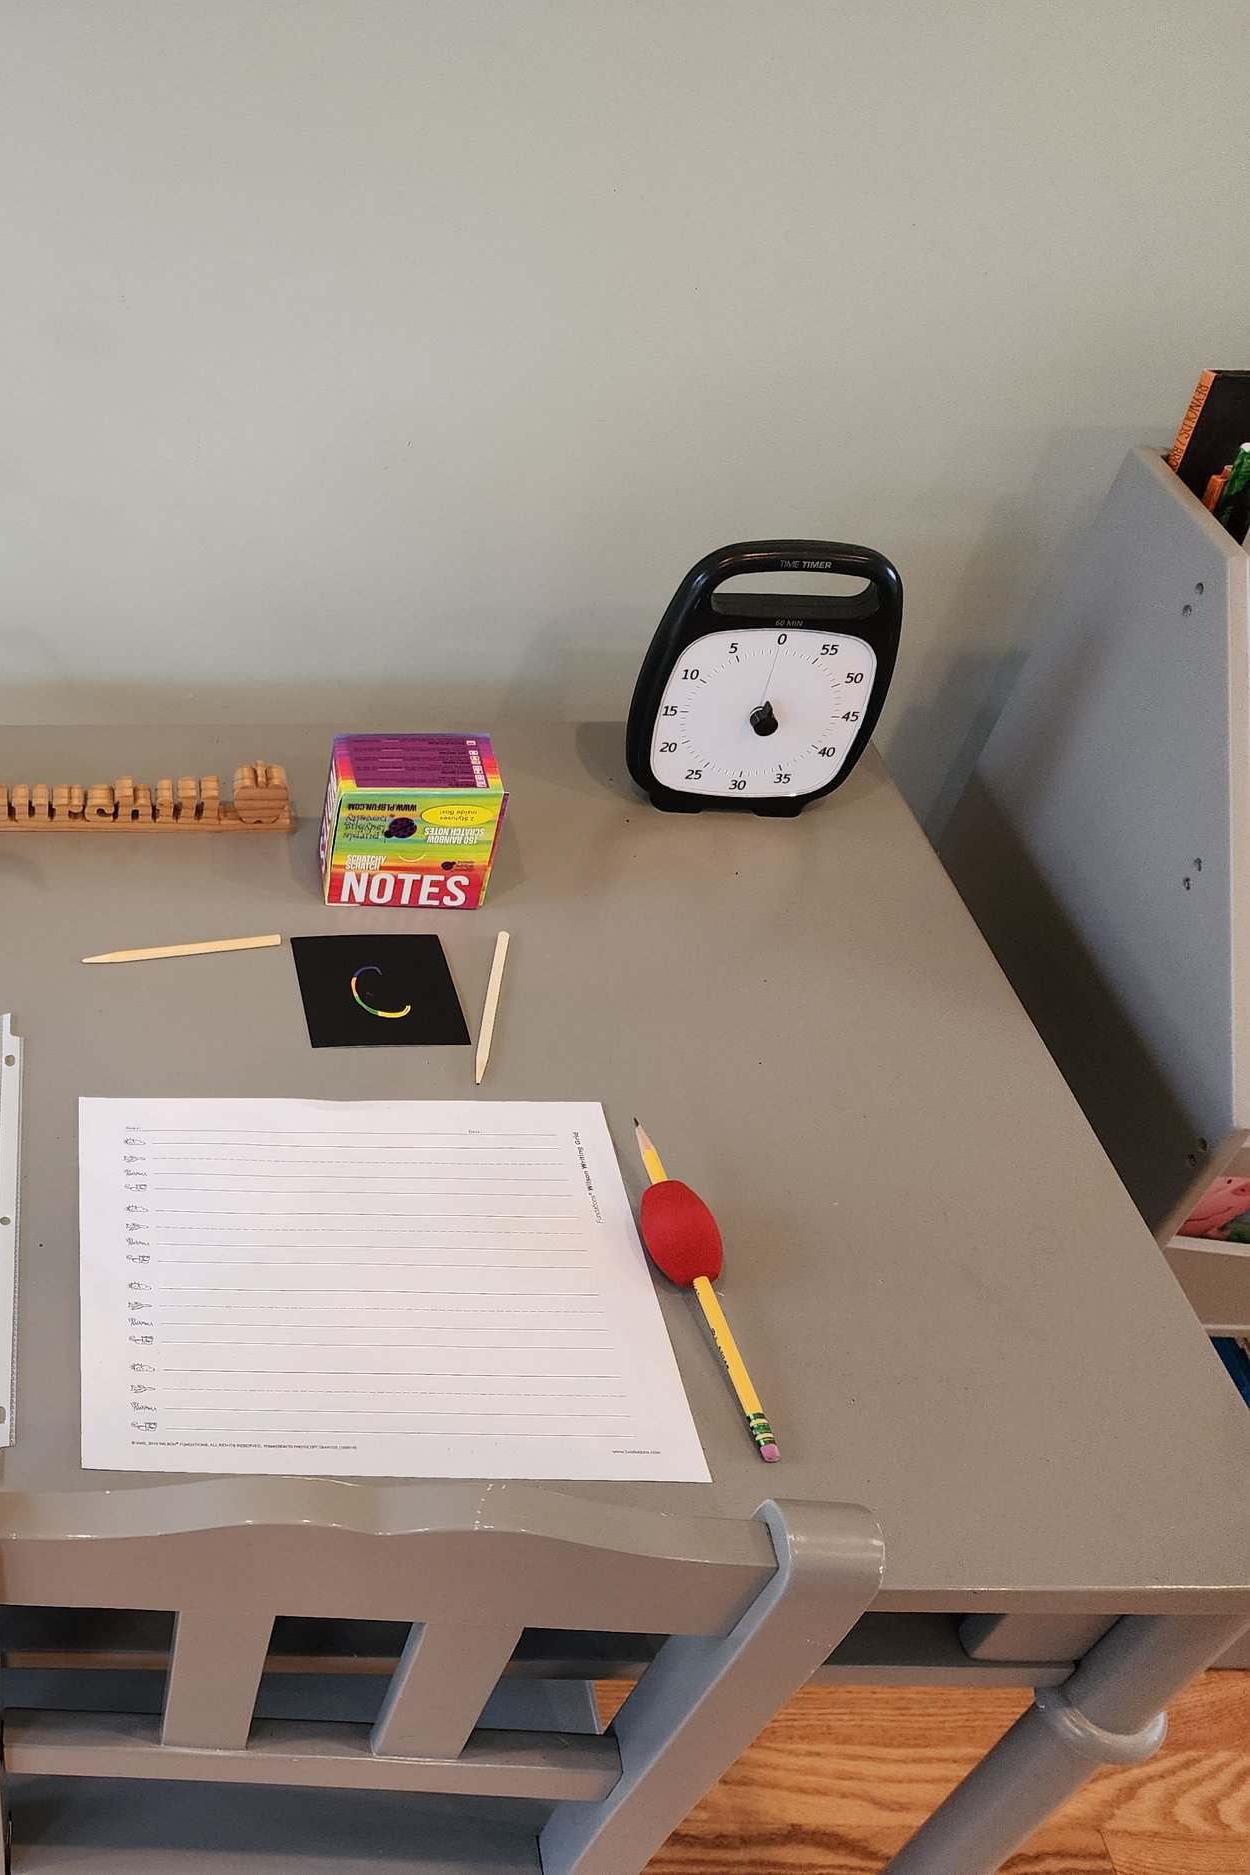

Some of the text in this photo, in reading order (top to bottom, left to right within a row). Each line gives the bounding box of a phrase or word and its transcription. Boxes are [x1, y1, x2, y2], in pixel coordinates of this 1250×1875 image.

[1178, 383, 1209, 439] REYNOLDS
[780, 559, 832, 570] TIME TIMER
[775, 619, 803, 627] 60 MIN
[777, 633, 788, 646] 0
[729, 643, 739, 654] 5
[820, 644, 839, 656] 55
[681, 668, 700, 681] 10
[845, 672, 864, 684] 50
[662, 706, 678, 717] 15
[841, 711, 860, 722] 45
[659, 742, 677, 753] 20
[818, 747, 836, 758] 40
[684, 769, 703, 781] 25
[773, 772, 792, 785] 35
[728, 780, 747, 792] 30
[348, 803, 417, 812] WWW.PLBFUN.COM
[345, 813, 387, 823] novelty
[344, 822, 387, 834] ladybug
[424, 827, 486, 836] SCRATCH NOTES
[342, 831, 379, 842] purple
[426, 835, 462, 844] RAINBOW
[346, 855, 386, 864] SCRATCHY
[345, 863, 380, 871] SCRATCH
[340, 872, 470, 906] NOTES
[573, 1131, 581, 1145] Grid
[578, 1146, 587, 1170] Writing
[584, 1170, 593, 1191] Wilson
